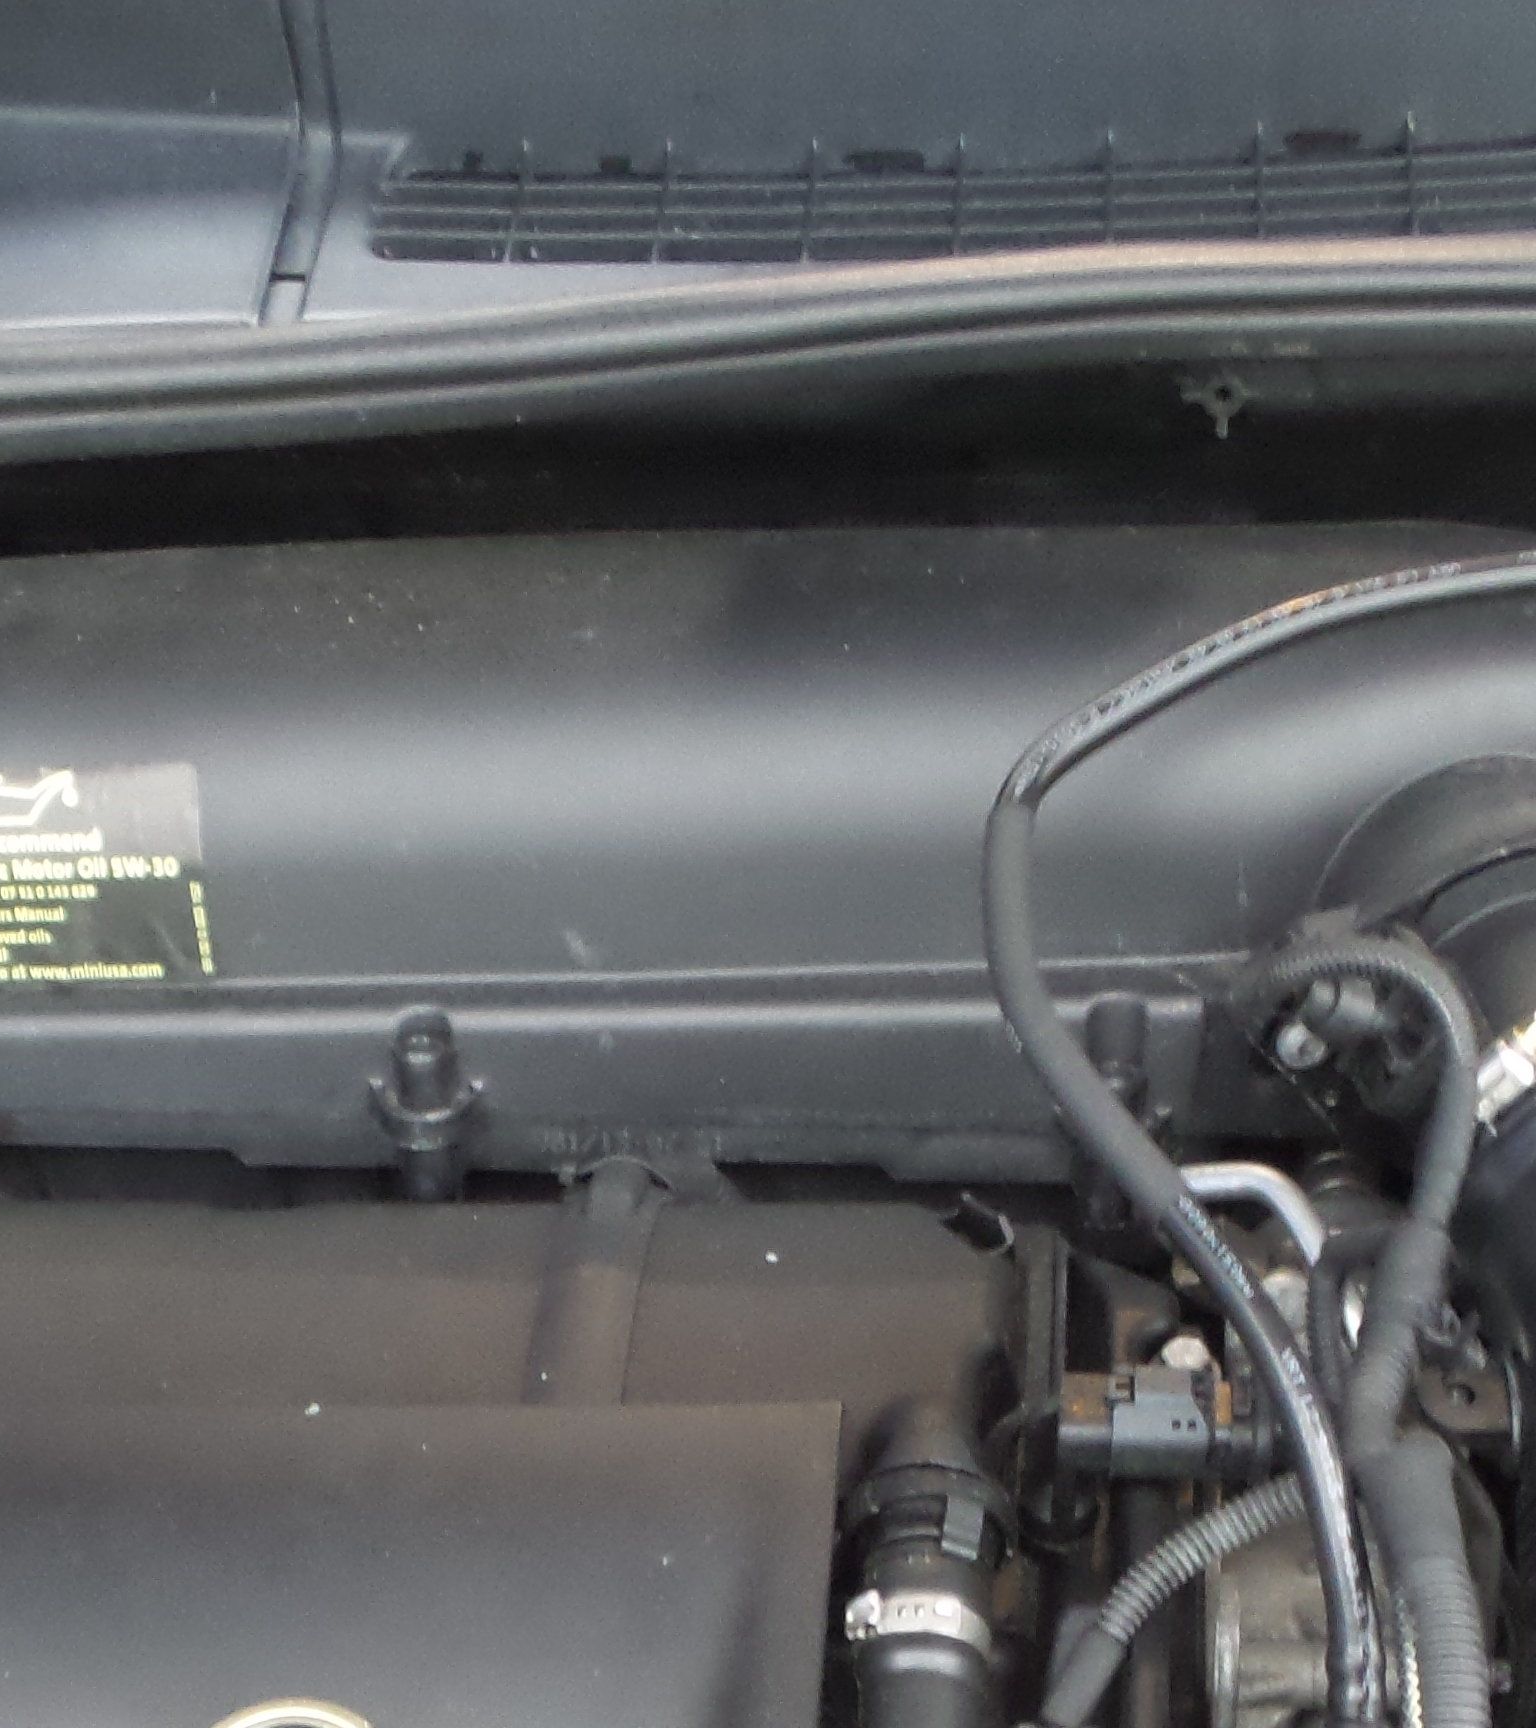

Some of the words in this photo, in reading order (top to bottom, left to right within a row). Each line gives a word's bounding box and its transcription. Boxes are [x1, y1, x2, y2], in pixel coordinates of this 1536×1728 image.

[12, 857, 74, 881] Motor
[77, 855, 108, 880] Oil
[111, 855, 181, 879] 5W-30
[14, 905, 65, 922] Manual
[28, 926, 53, 944] oils
[12, 963, 29, 979] at
[30, 961, 164, 980] www.miniusa.com
